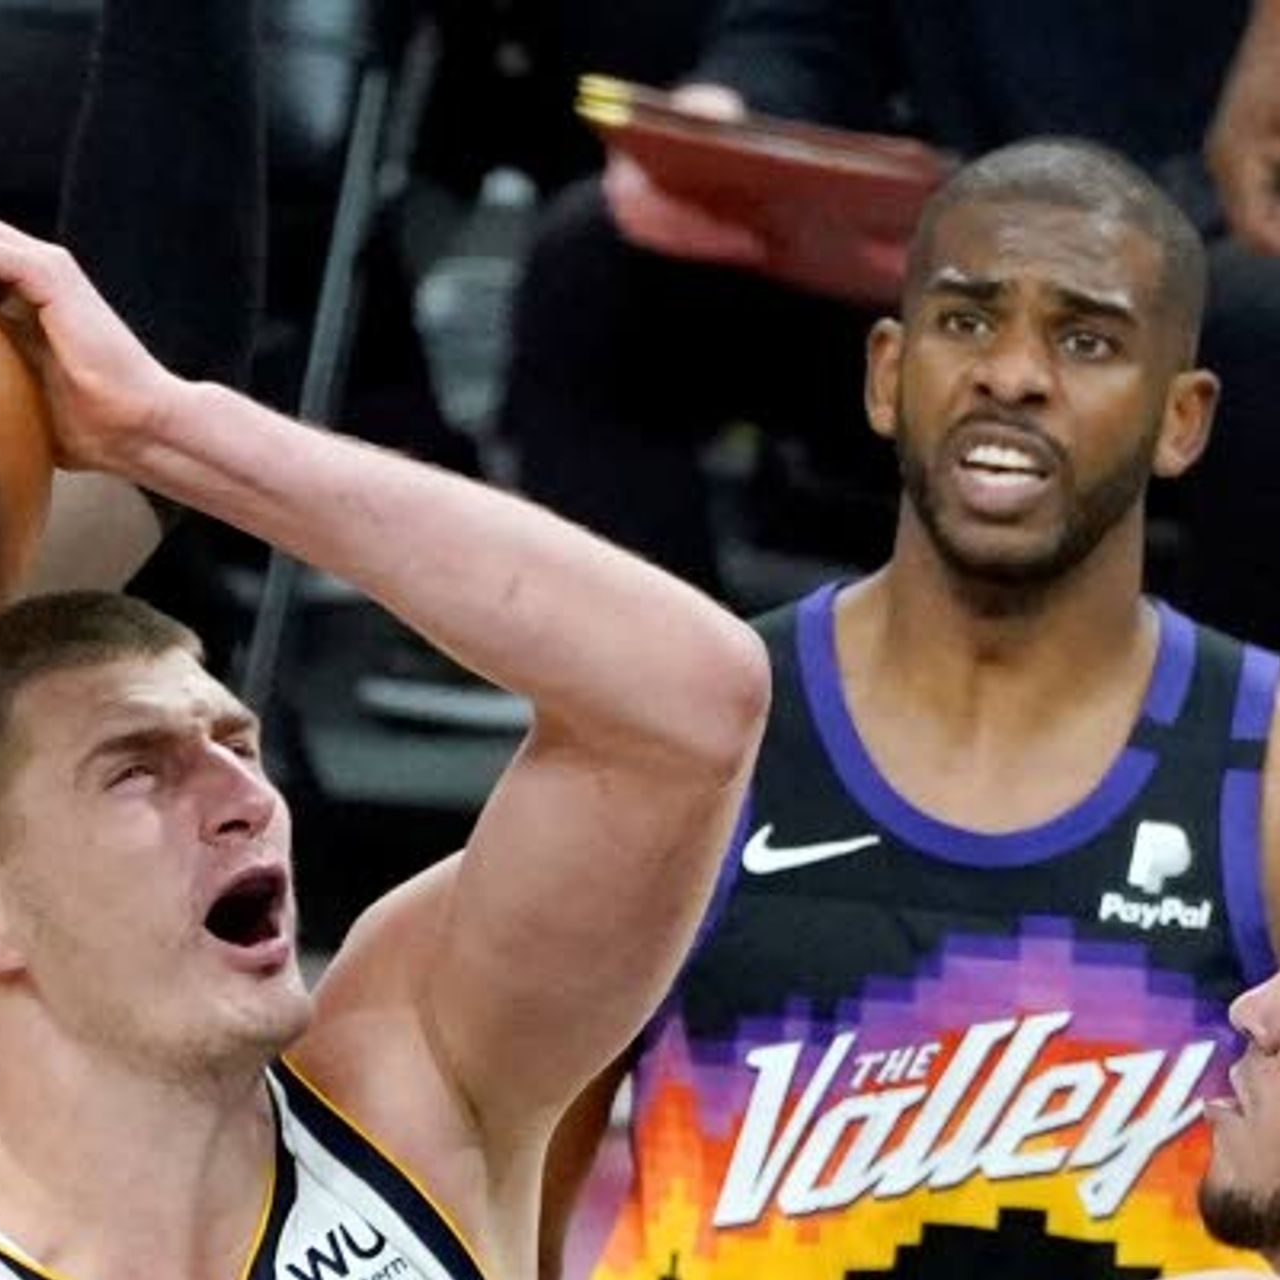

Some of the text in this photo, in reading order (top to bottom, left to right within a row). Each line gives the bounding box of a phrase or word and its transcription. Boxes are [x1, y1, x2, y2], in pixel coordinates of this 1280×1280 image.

[1098, 891, 1212, 931] PayPal
[852, 1041, 942, 1089] THE
[713, 1010, 1217, 1229] Valley
